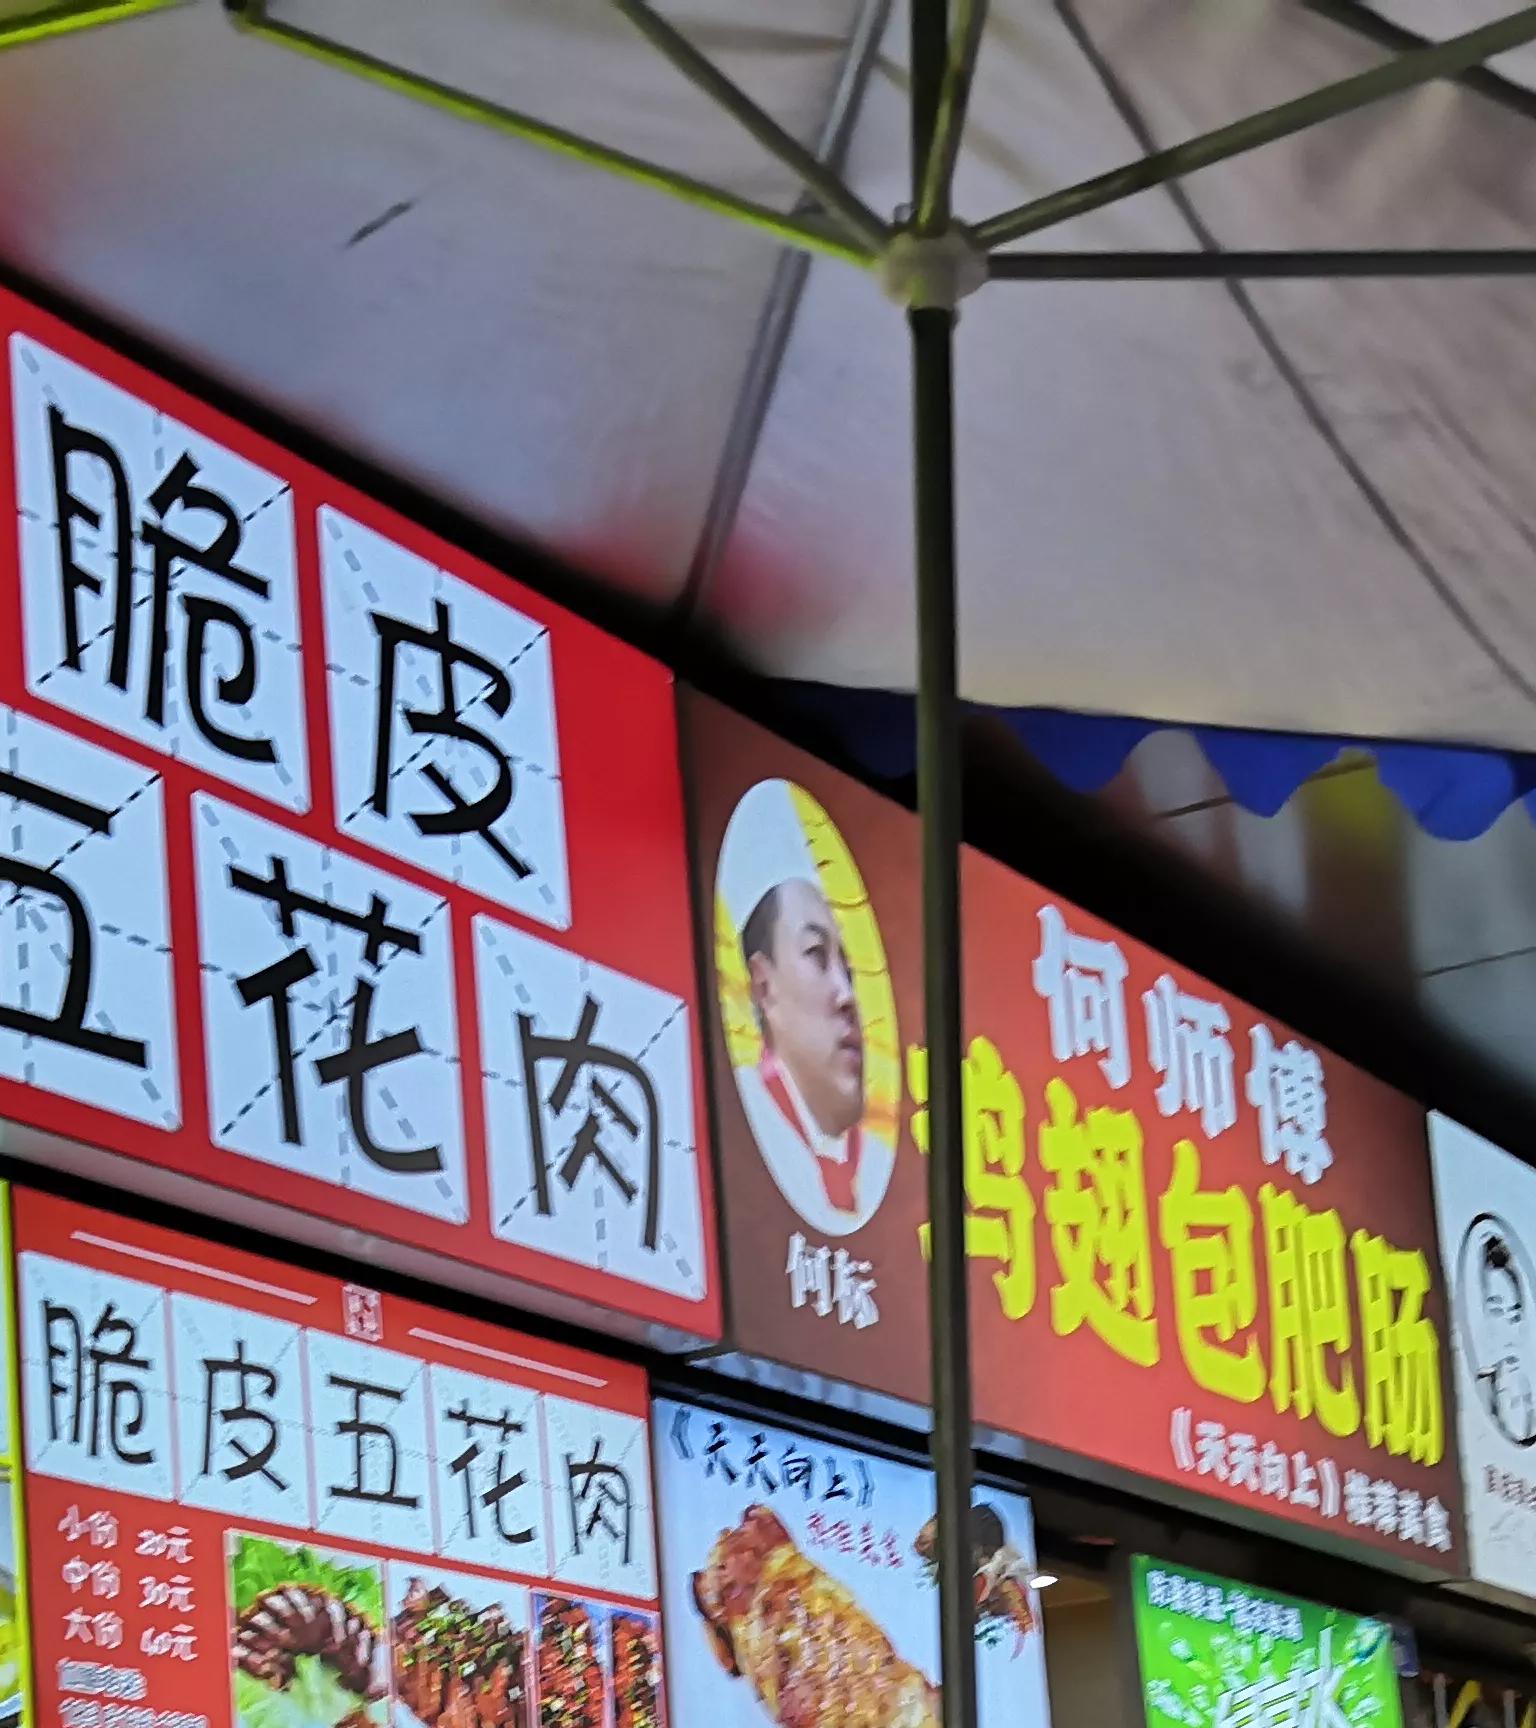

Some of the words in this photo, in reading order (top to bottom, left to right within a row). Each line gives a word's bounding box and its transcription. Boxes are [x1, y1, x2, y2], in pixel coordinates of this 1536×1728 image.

[45, 405, 535, 879] 脆皮
[1031, 904, 1333, 1185] 何师傅
[906, 1035, 1444, 1467] 鸡翅包肥肠
[39, 1298, 634, 1565] 脆皮五花肉
[57, 1505, 119, 1547] 小份
[61, 1558, 122, 1598] 中份
[63, 1607, 123, 1648] 大份
